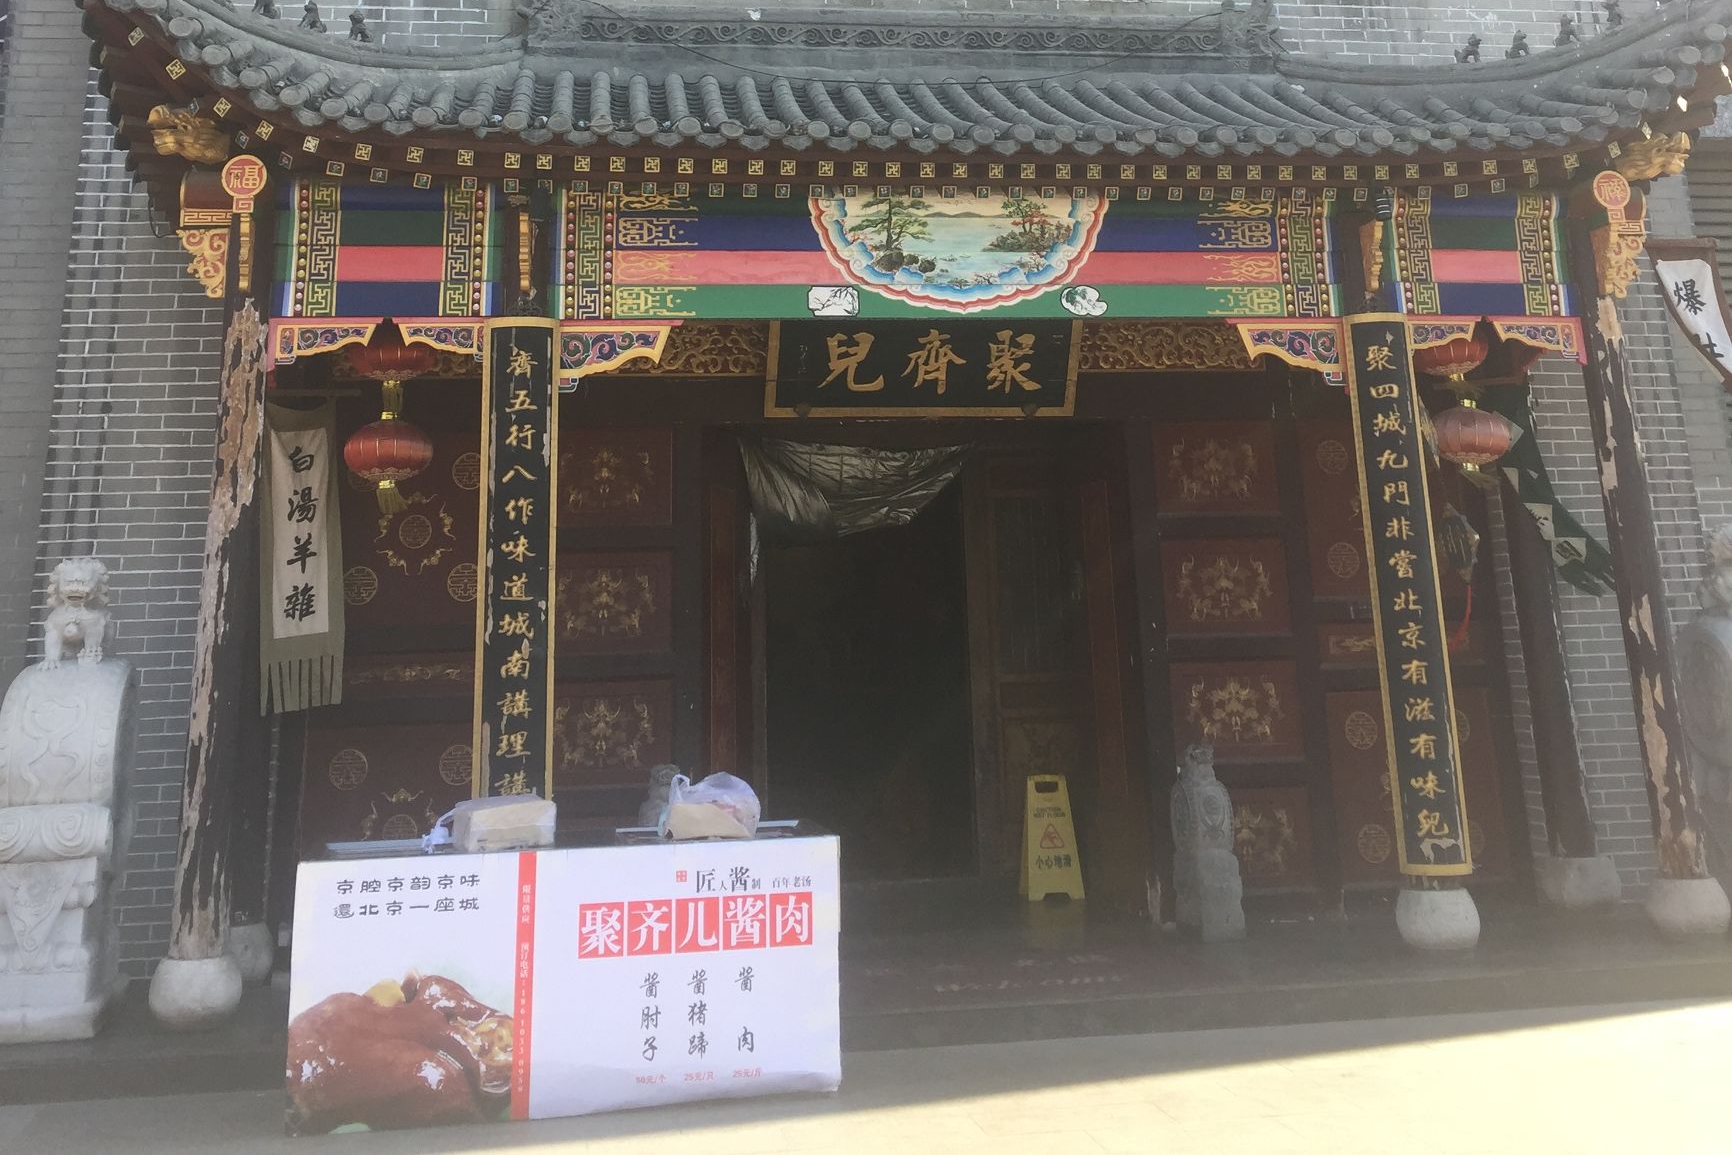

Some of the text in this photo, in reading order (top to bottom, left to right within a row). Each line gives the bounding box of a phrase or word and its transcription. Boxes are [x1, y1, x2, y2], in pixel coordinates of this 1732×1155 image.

[230, 165, 263, 189] 福
[284, 445, 319, 623] 白湯羊雜
[336, 874, 480, 895] 京腔京韵京味
[696, 866, 761, 893] 匠人酱制
[334, 897, 480, 919] 還北京一座城
[579, 894, 812, 957] 聚齐儿酱肉
[639, 972, 662, 1062] 酱肘子
[687, 968, 709, 1060] 酱猪蹄
